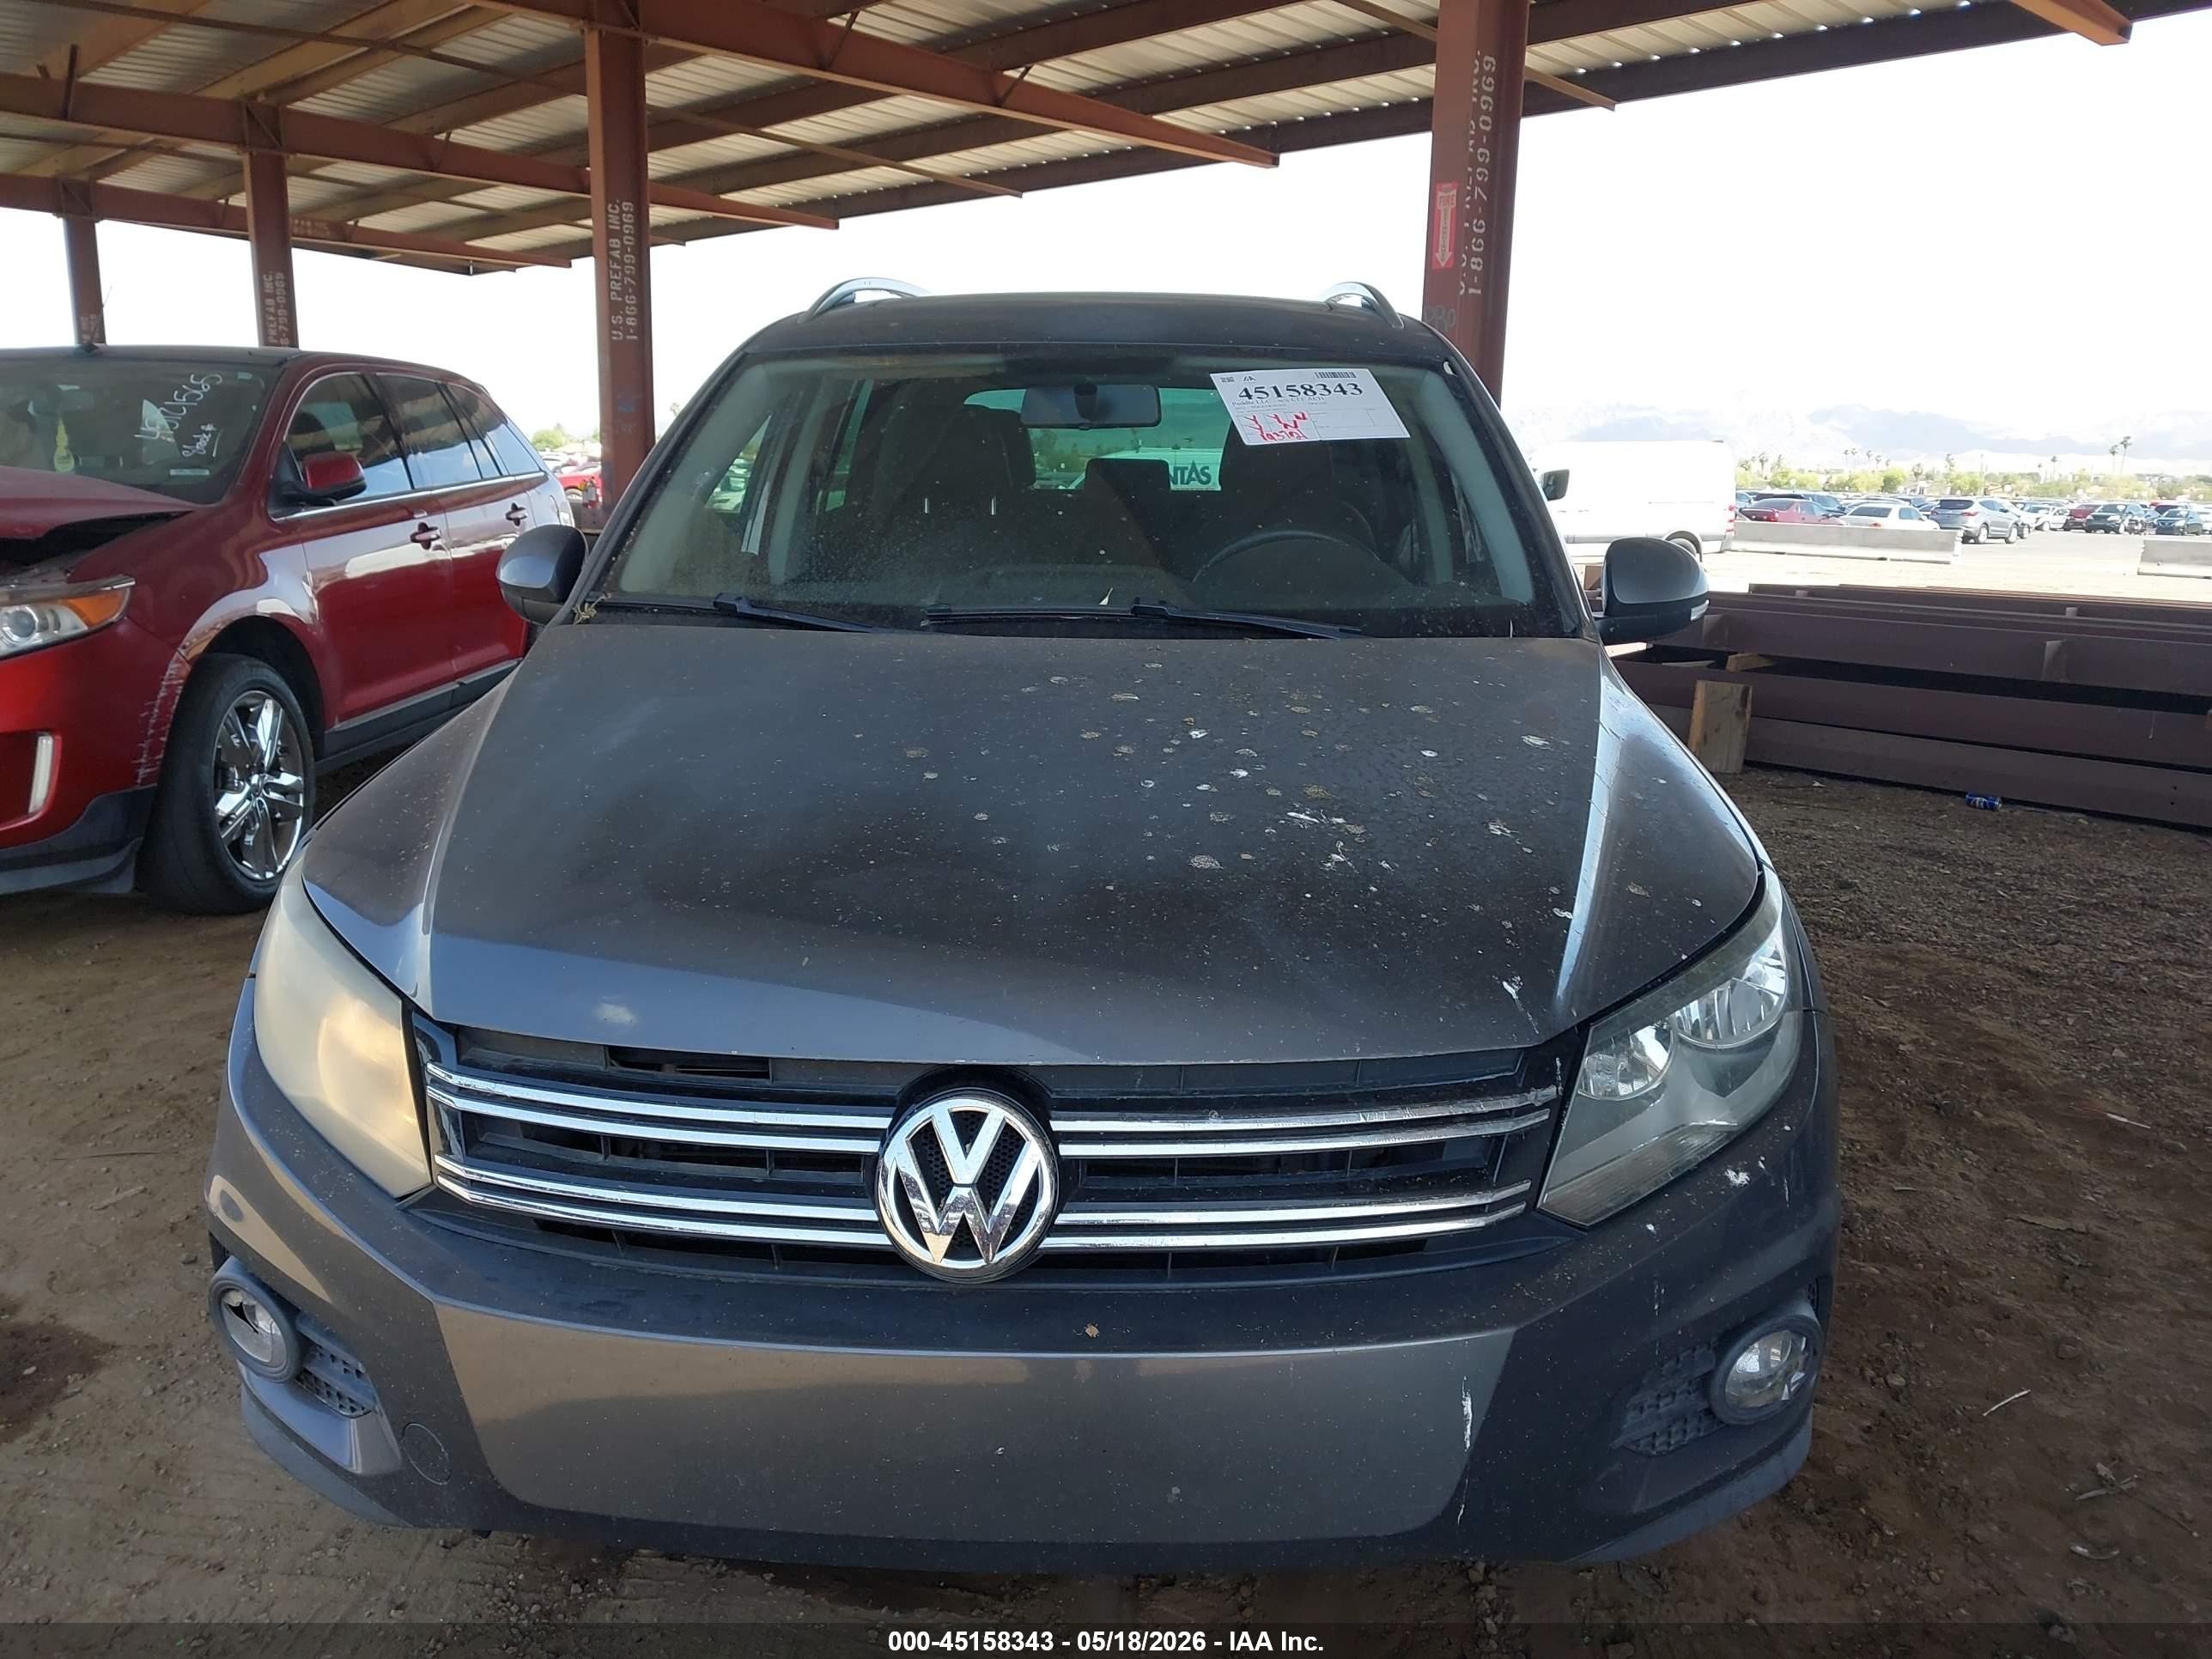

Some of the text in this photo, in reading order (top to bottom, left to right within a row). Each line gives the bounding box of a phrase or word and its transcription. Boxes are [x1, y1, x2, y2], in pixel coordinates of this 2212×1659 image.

[1468, 55, 1497, 294] 1-866-799-0969
[607, 199, 623, 341] U.S. PREFAB INC.
[622, 201, 638, 340] 1-866-799-0969
[1237, 383, 1363, 400] 45158343
